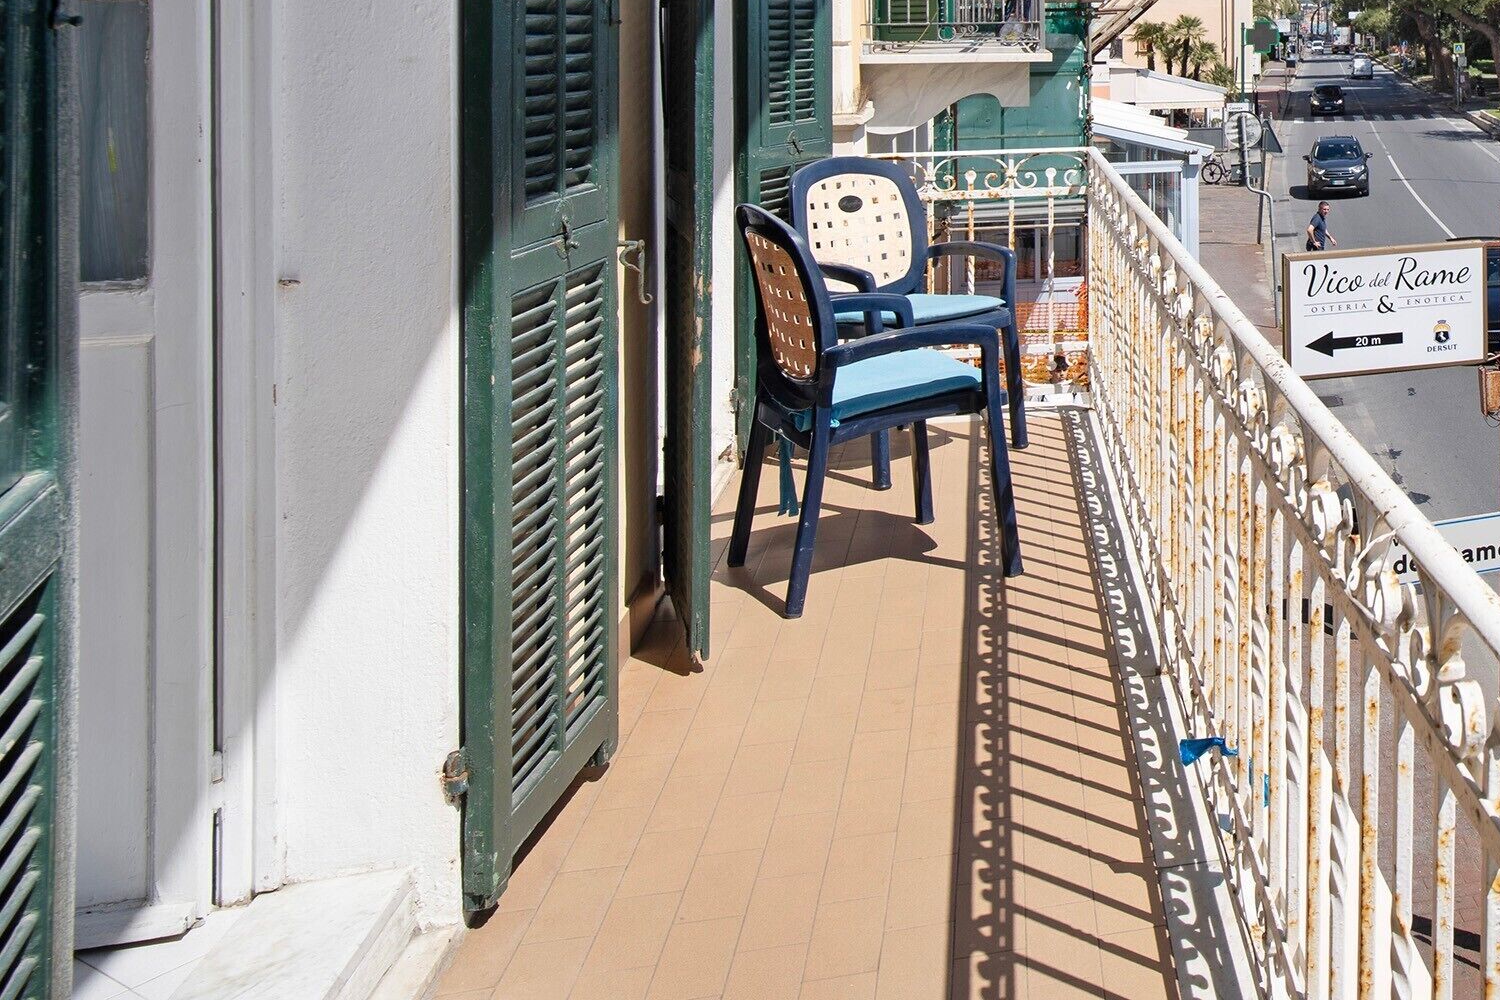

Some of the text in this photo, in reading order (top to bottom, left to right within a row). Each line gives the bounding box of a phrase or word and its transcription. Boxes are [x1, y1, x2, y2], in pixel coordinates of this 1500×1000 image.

[1303, 256, 1471, 298] Vico del Rame
[1311, 294, 1465, 314] OSTERIA & ENOTECA
[1355, 336, 1381, 347] 20 m
[1426, 344, 1458, 353] DERSUT
